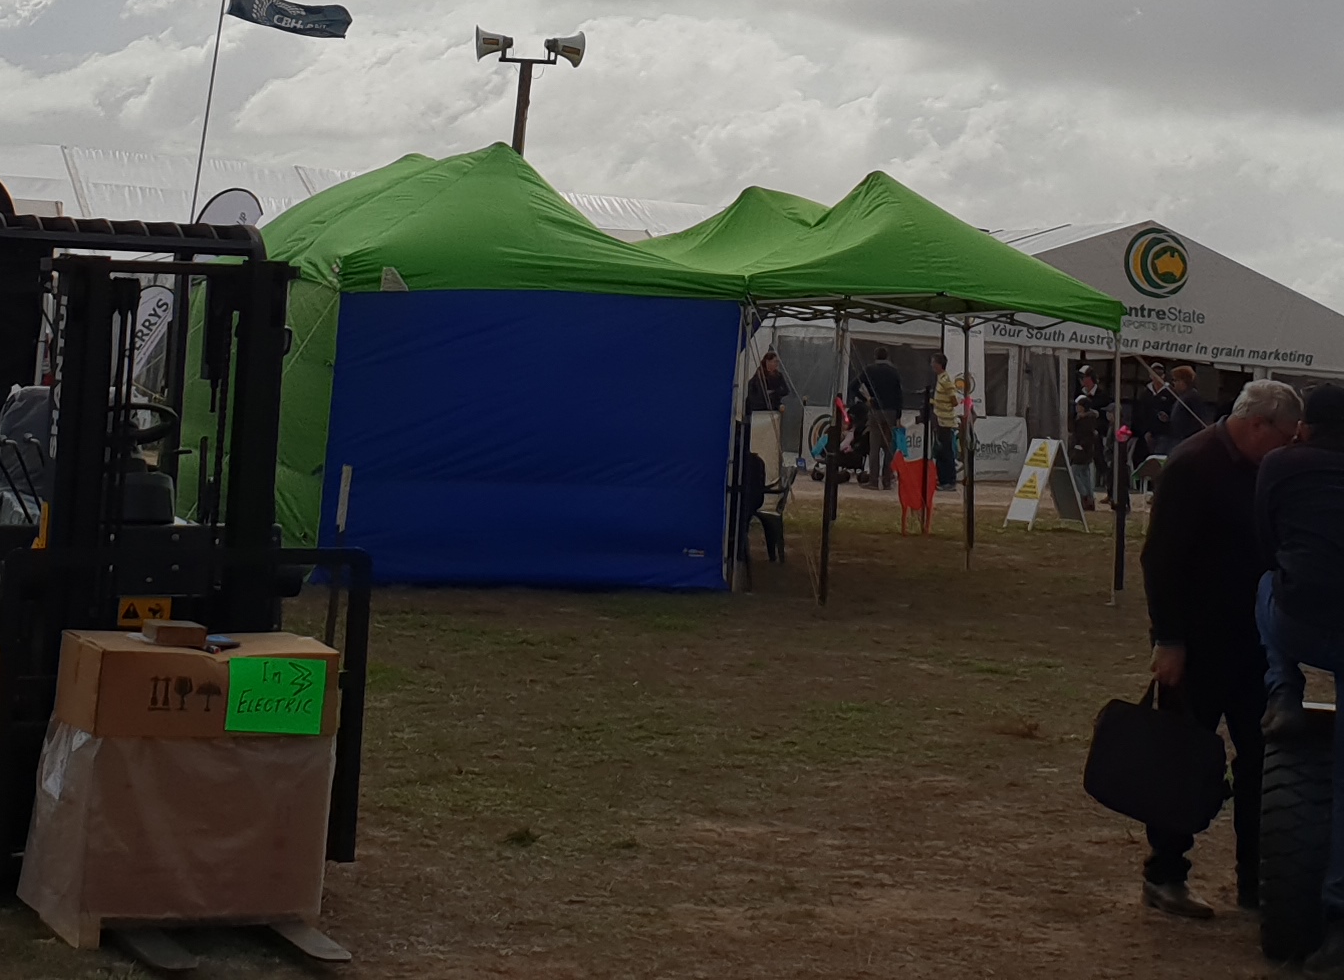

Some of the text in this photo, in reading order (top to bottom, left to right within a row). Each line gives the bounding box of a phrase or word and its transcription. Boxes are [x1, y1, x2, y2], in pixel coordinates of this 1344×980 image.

[133, 297, 170, 353] ERRYS
[991, 323, 1023, 338] Your
[1025, 327, 1065, 343] South
[1142, 337, 1193, 354] partner
[1195, 342, 1208, 355] in
[1211, 345, 1245, 359] grain
[1247, 348, 1314, 366] marketing
